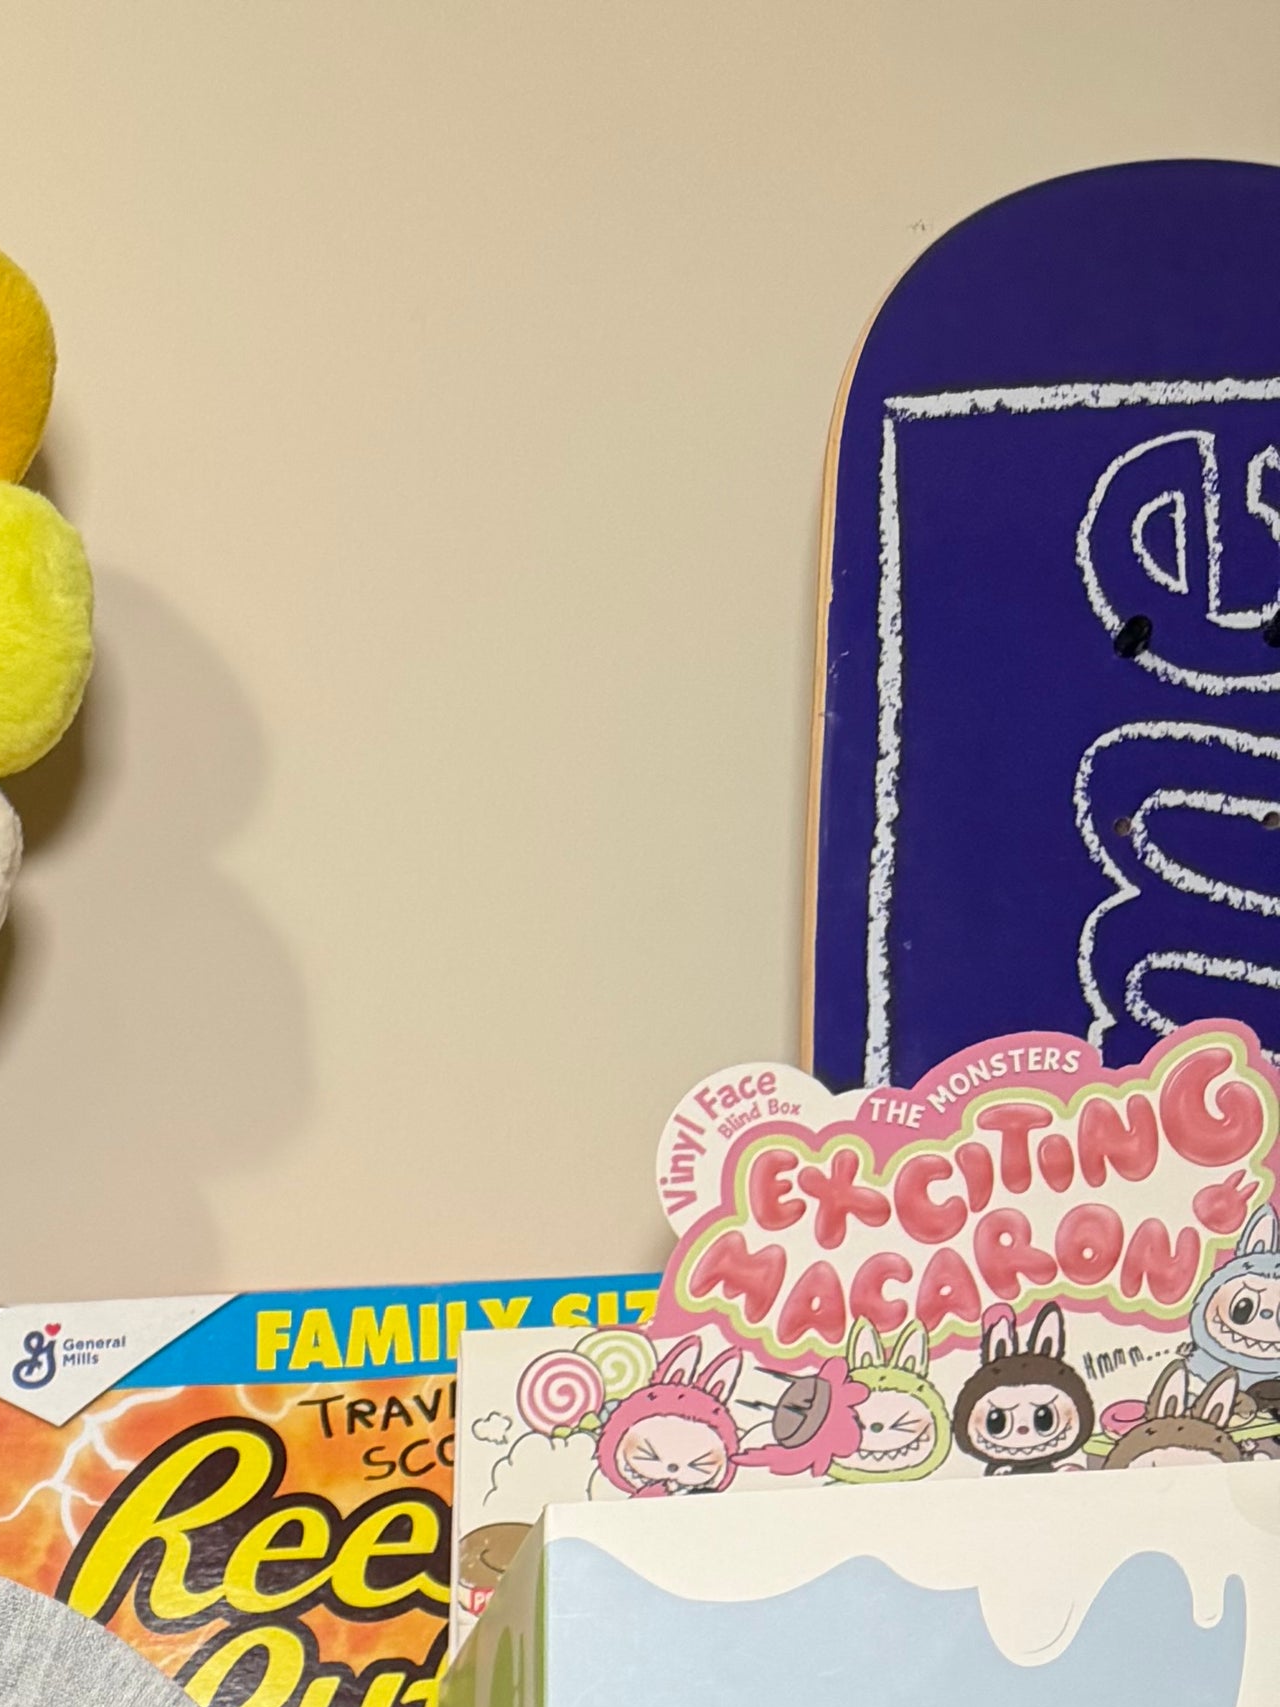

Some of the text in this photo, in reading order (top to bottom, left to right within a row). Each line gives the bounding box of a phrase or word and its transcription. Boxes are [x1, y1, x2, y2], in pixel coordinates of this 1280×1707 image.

[718, 1097, 802, 1141] Blind Box
[869, 1046, 1083, 1130] THE MONSTERS
[659, 1068, 778, 1217] Vinyl Face
[688, 1202, 1201, 1346] MACARON
[61, 1335, 128, 1352] General
[61, 1350, 101, 1368] Mills
